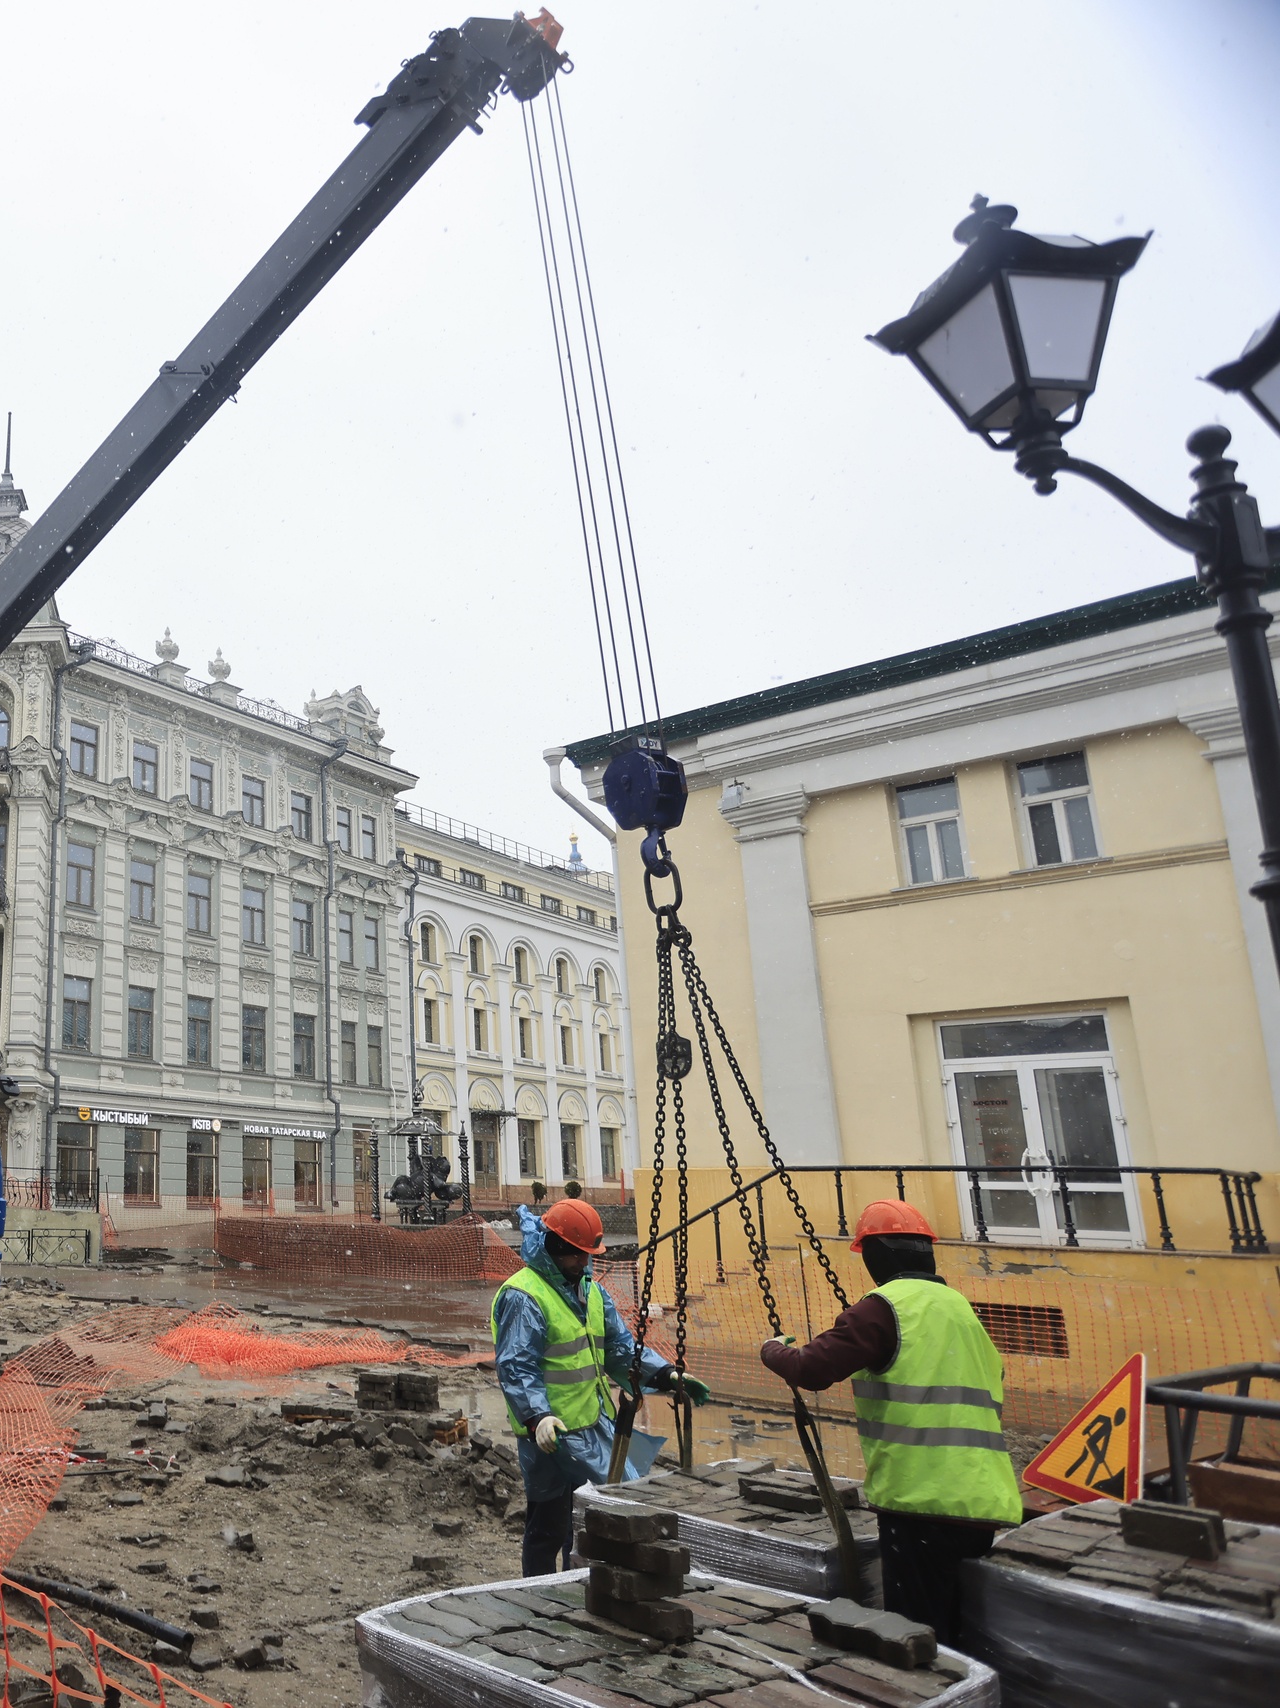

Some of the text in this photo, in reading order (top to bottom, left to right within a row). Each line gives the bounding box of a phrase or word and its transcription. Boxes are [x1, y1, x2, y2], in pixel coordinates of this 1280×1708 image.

[92, 1109, 149, 1126] КЫСТЫБЫЙ
[191, 1118, 212, 1131] KSTB
[243, 1124, 328, 1140] НОВАЯ ТАТАРСКАЯ ЕДА
